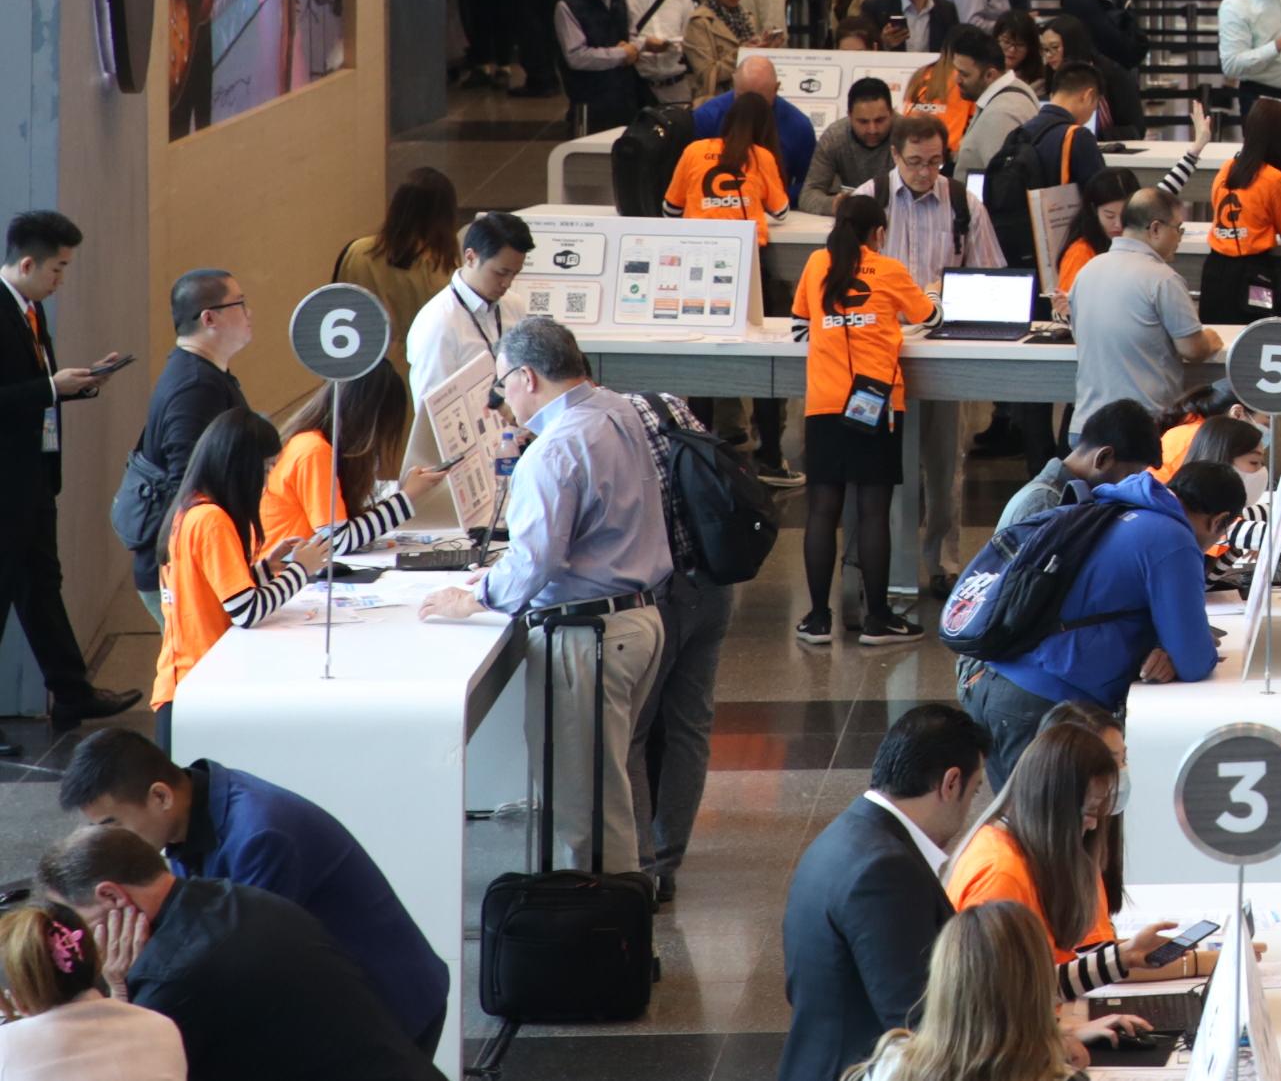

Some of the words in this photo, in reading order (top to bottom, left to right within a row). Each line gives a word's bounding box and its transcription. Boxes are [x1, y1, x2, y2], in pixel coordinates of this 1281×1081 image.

[702, 193, 749, 209] Badge
[319, 308, 361, 359] 6
[822, 311, 877, 330] Badge
[1215, 760, 1269, 834] 3
